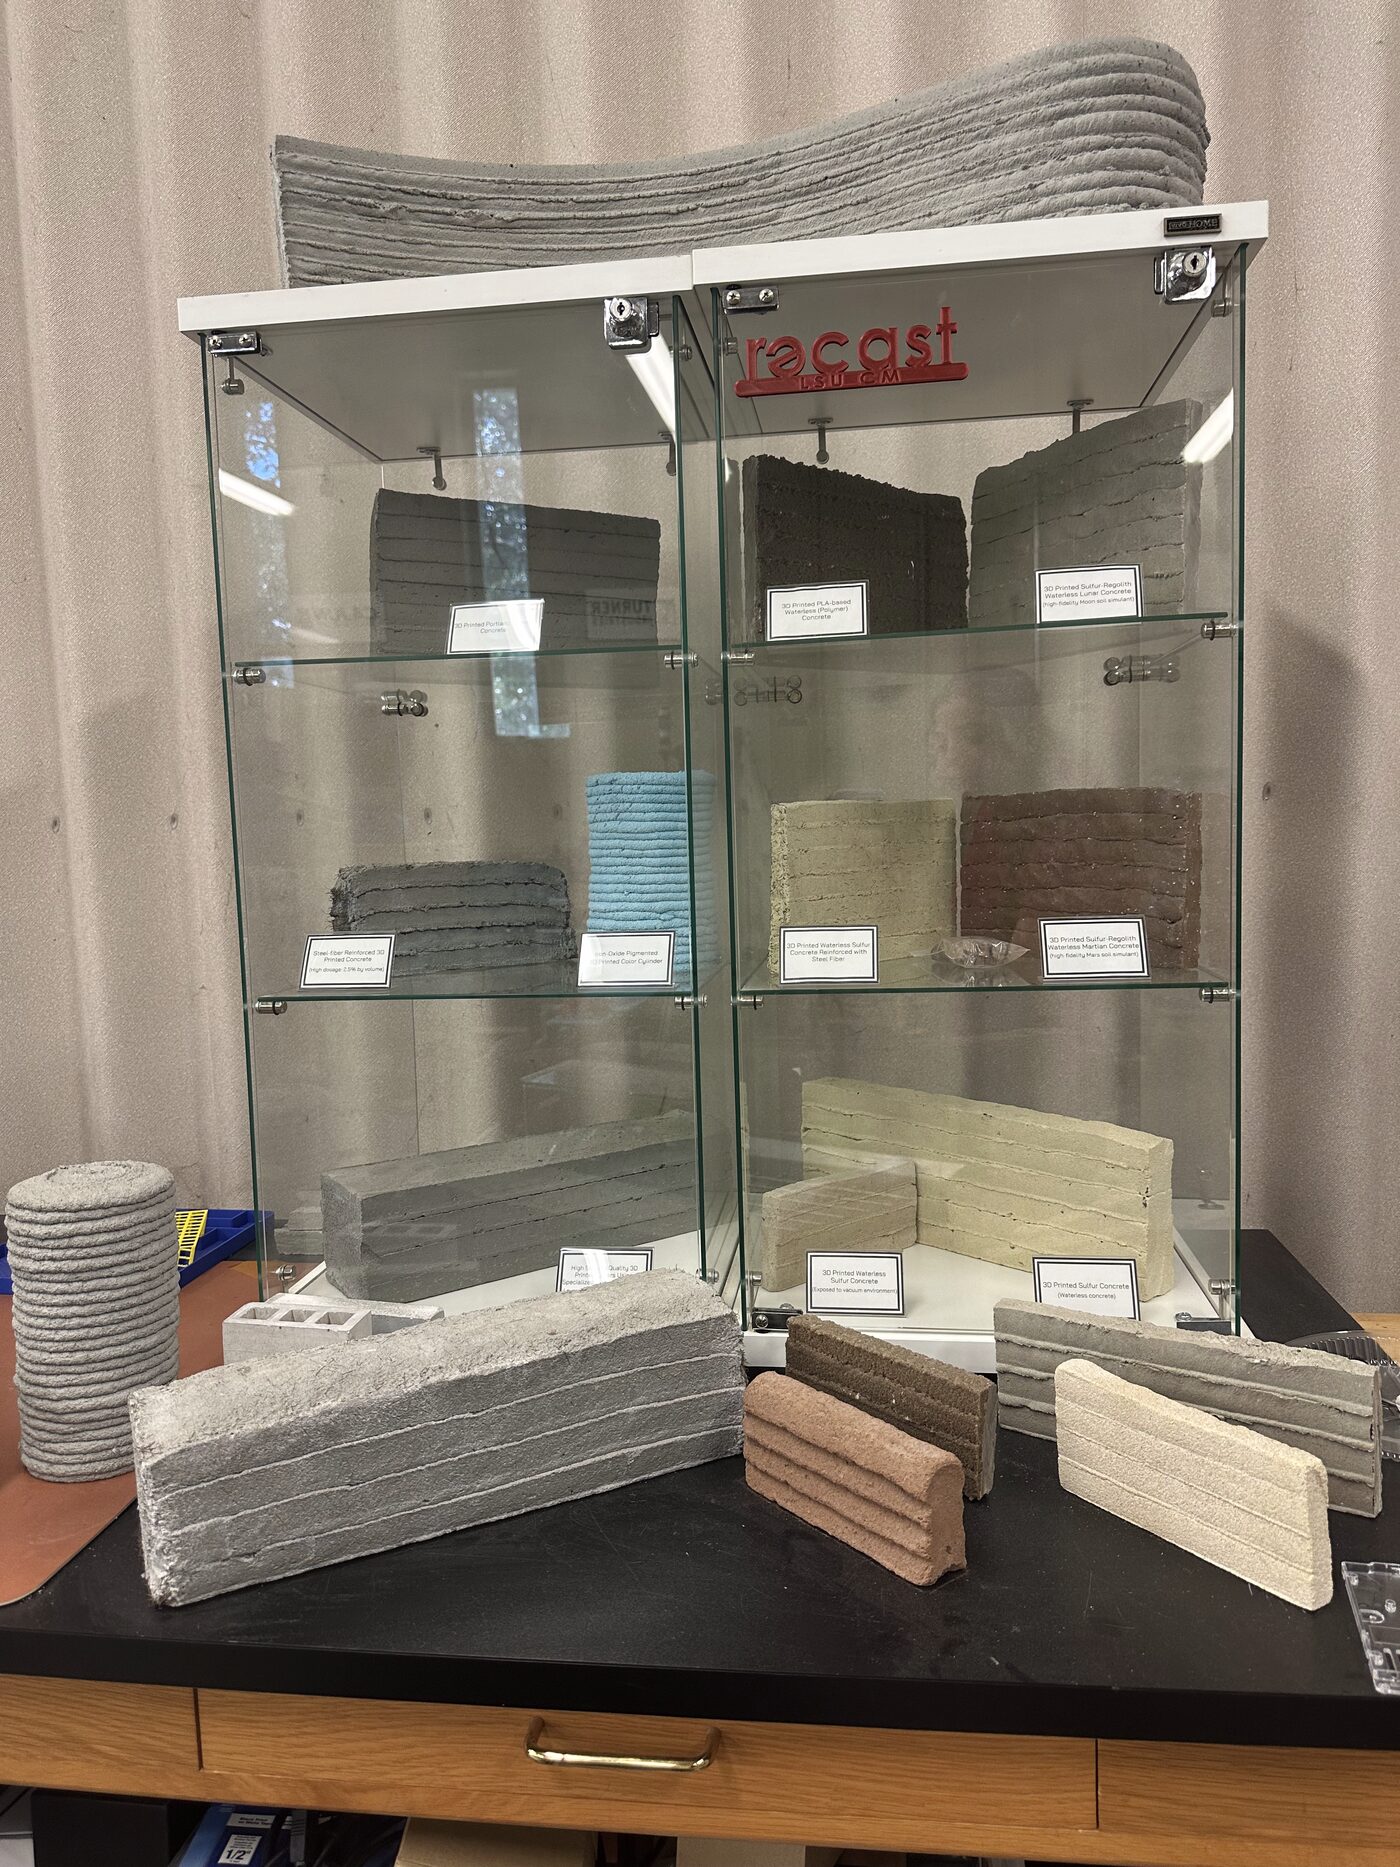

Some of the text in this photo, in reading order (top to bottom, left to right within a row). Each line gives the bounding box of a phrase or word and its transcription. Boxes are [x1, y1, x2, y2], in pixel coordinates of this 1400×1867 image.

[801, 373, 844, 390] LSU
[1044, 585, 1054, 593] 3D
[1055, 583, 1080, 591] Printed
[1045, 588, 1132, 600] Waterless Lunar Concrete
[816, 599, 852, 607] PLA-based
[784, 608, 816, 616] Waterless
[1048, 943, 1080, 951] Waterless
[1082, 942, 1108, 950] Martian
[832, 1269, 854, 1277] Printed
[850, 1277, 878, 1285] Concrete
[1053, 1281, 1077, 1289] Printed
[1078, 1282, 1098, 1290] Sulfur
[1099, 1282, 1130, 1290] Concrete
